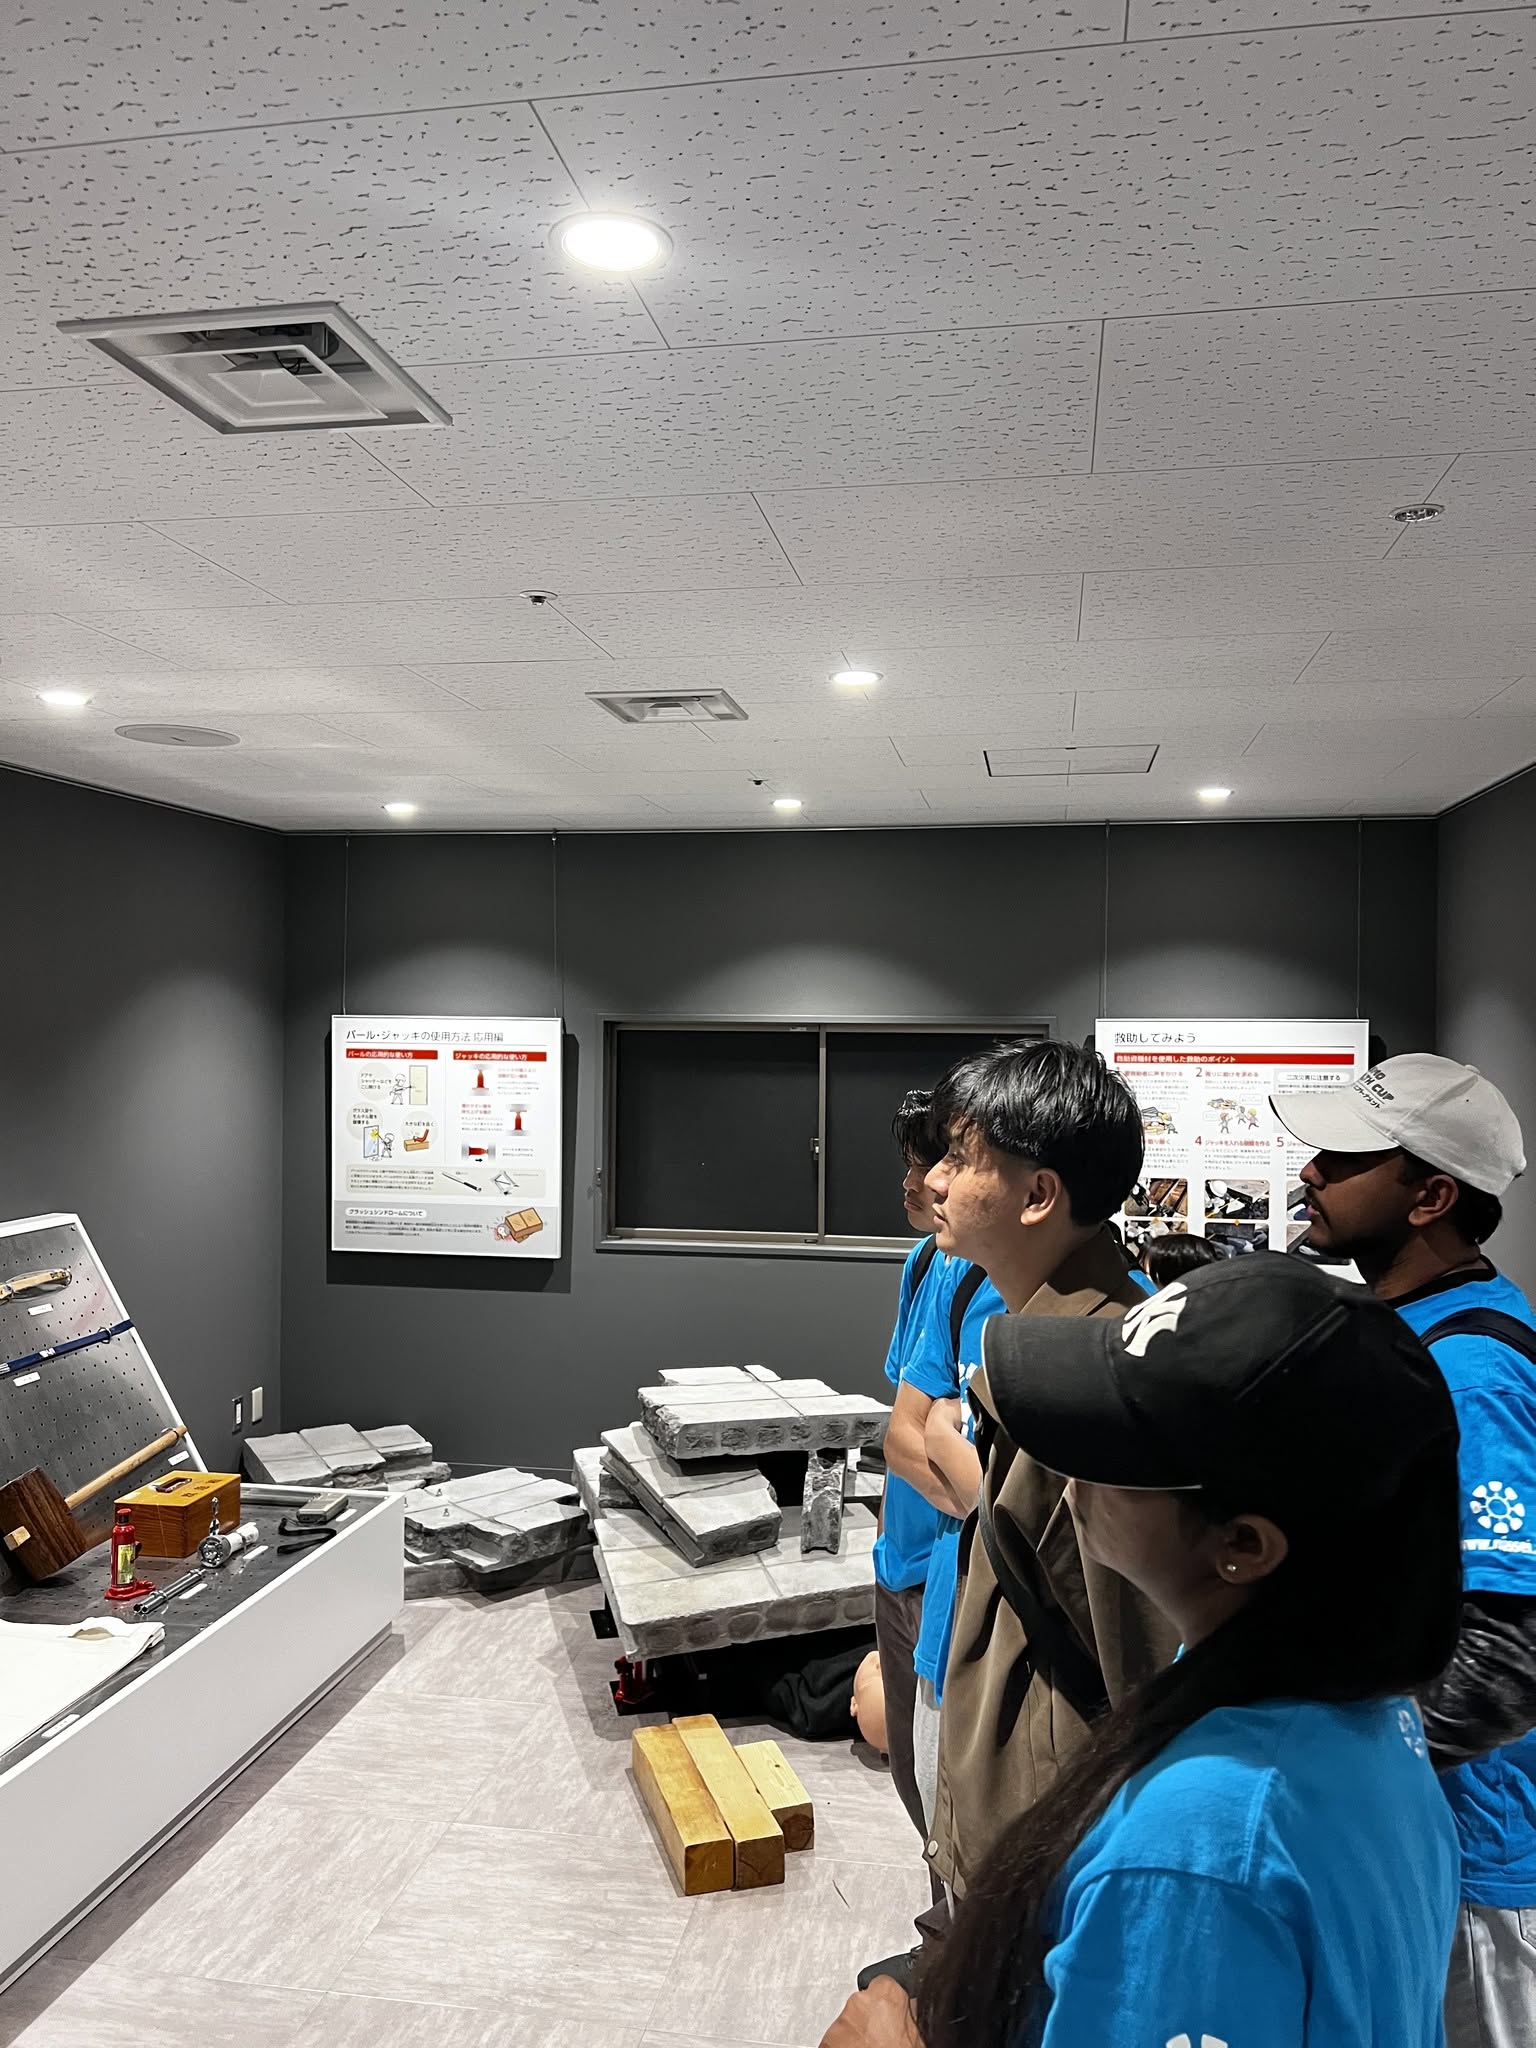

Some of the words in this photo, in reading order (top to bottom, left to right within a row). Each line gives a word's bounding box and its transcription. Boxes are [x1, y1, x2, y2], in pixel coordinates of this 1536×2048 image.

[346, 1029, 471, 1042] バール・ジャッキの使用方法
[1114, 1032, 1197, 1044] 救助してみよう
[1195, 1066, 1203, 1078] 2
[1371, 1083, 1395, 1101] CUP
[1194, 1135, 1202, 1146] 4
[1276, 1136, 1285, 1147] 5
